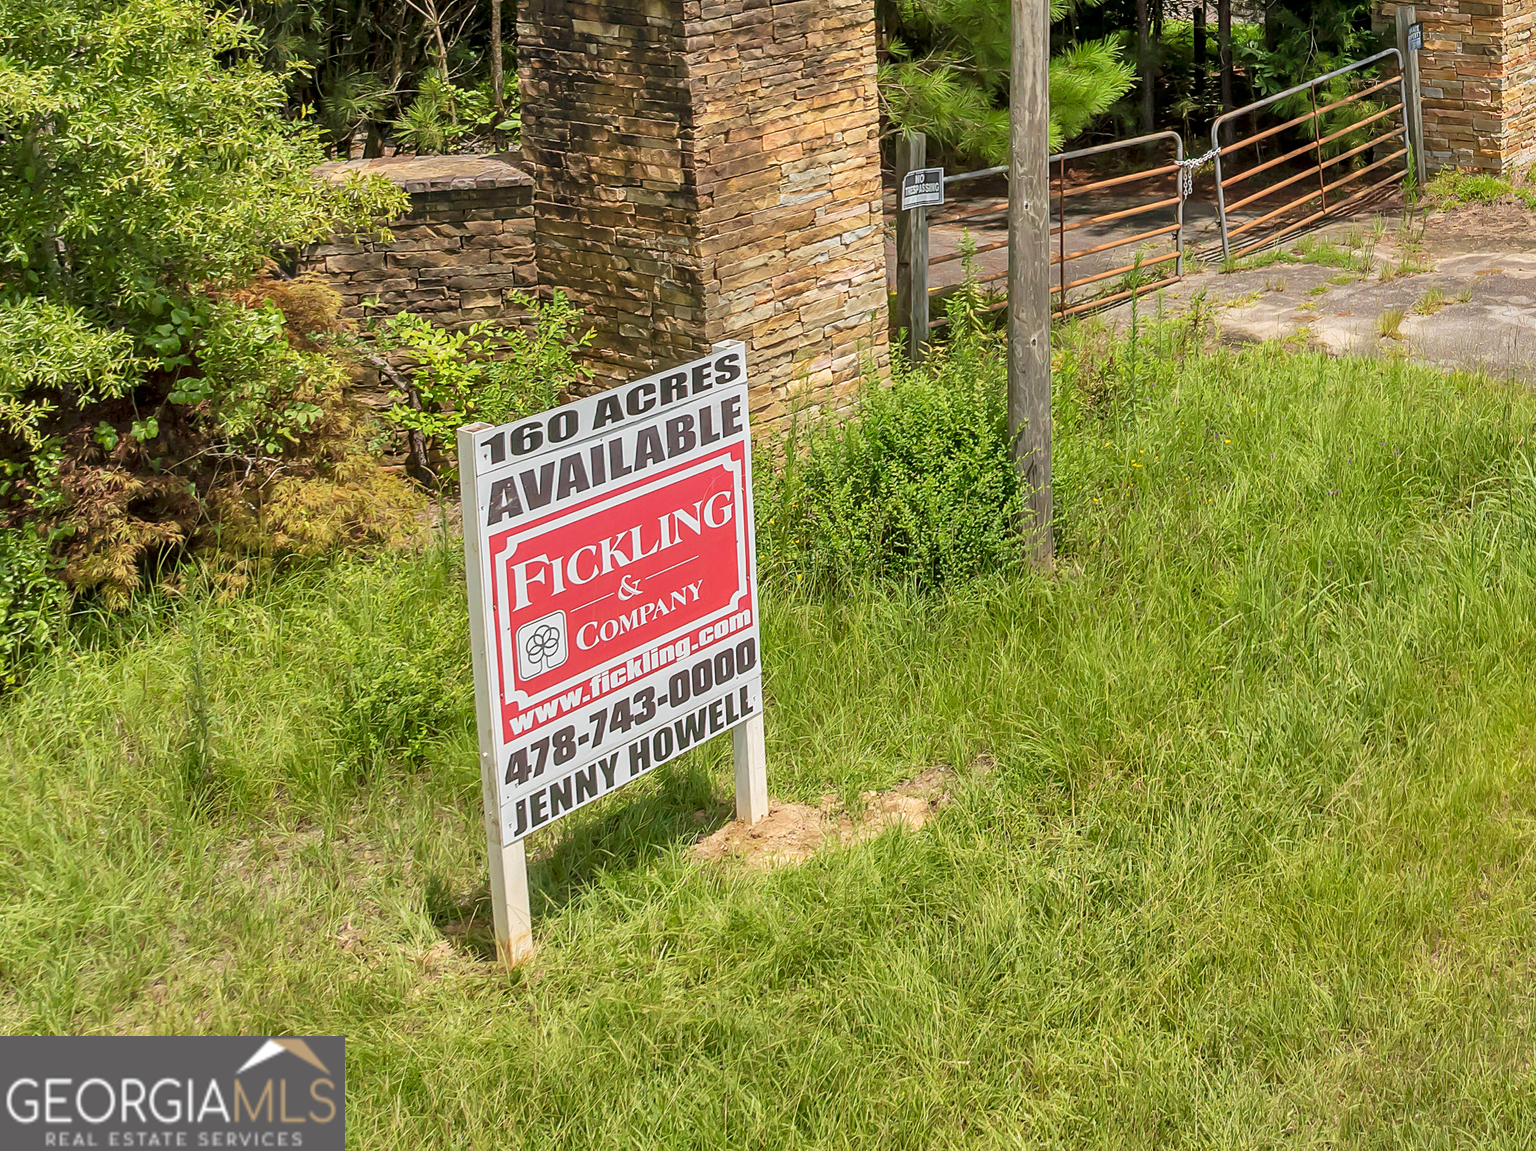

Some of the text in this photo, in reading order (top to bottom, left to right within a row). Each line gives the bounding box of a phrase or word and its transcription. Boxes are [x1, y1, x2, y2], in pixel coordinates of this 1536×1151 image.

[904, 182, 940, 197] TRESPASSING
[914, 173, 926, 185] NO
[480, 353, 741, 466] 160 ACRES
[486, 394, 744, 527] AVAILABLE
[510, 490, 734, 613] FICKLING
[617, 574, 644, 601] &
[508, 607, 752, 736] www.fickling.com
[575, 579, 704, 651] COMPANY
[504, 636, 757, 786] 478-743-0000
[513, 684, 755, 837] JENNY HOWELL
